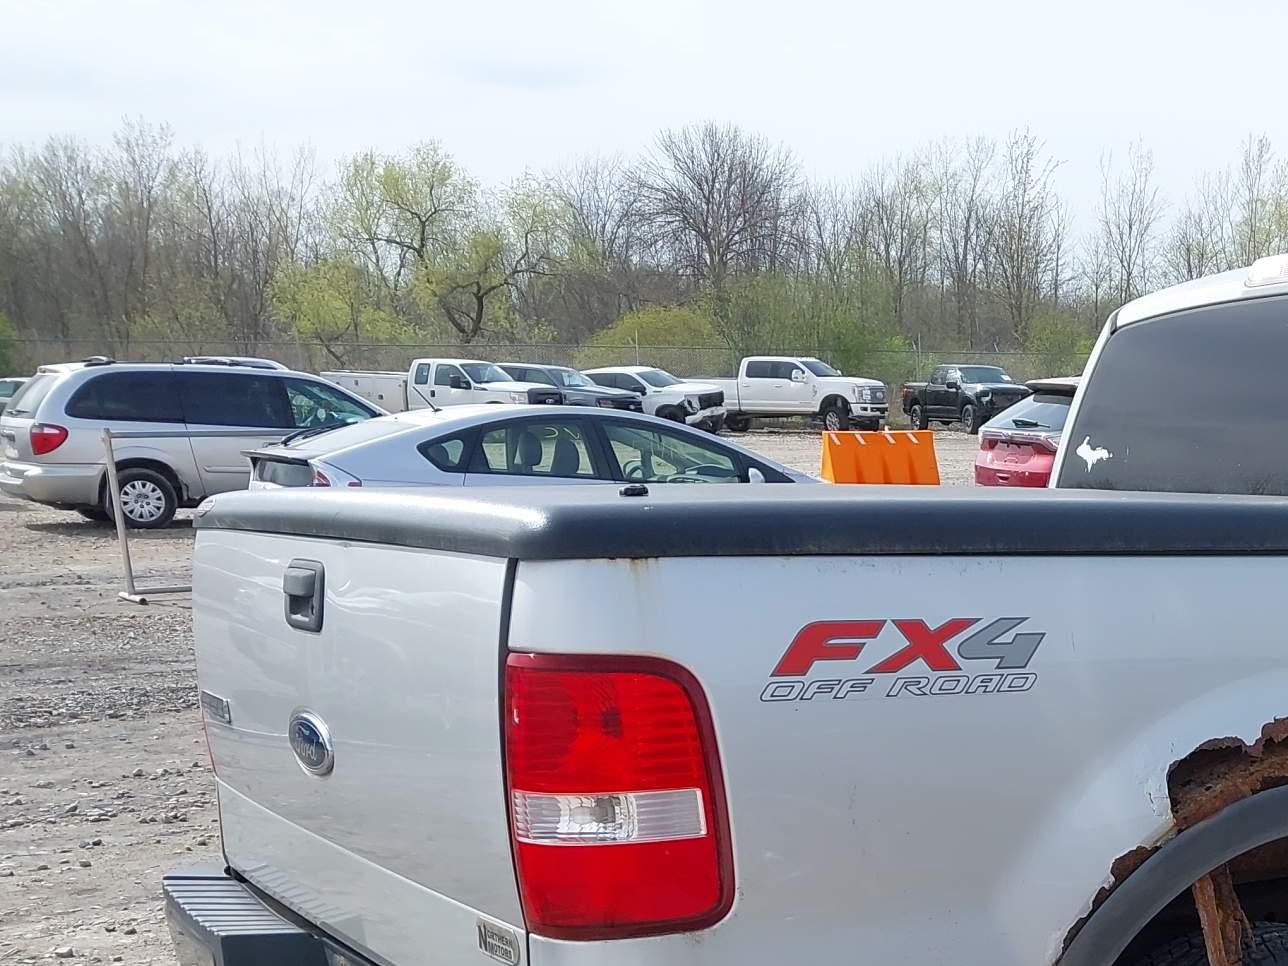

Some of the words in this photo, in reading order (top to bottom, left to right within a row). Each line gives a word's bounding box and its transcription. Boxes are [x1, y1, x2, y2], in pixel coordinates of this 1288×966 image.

[769, 617, 1047, 678] FX4
[759, 678, 876, 702] OFF
[885, 672, 1038, 698] ROAD
[487, 940, 513, 961] MOTORS
